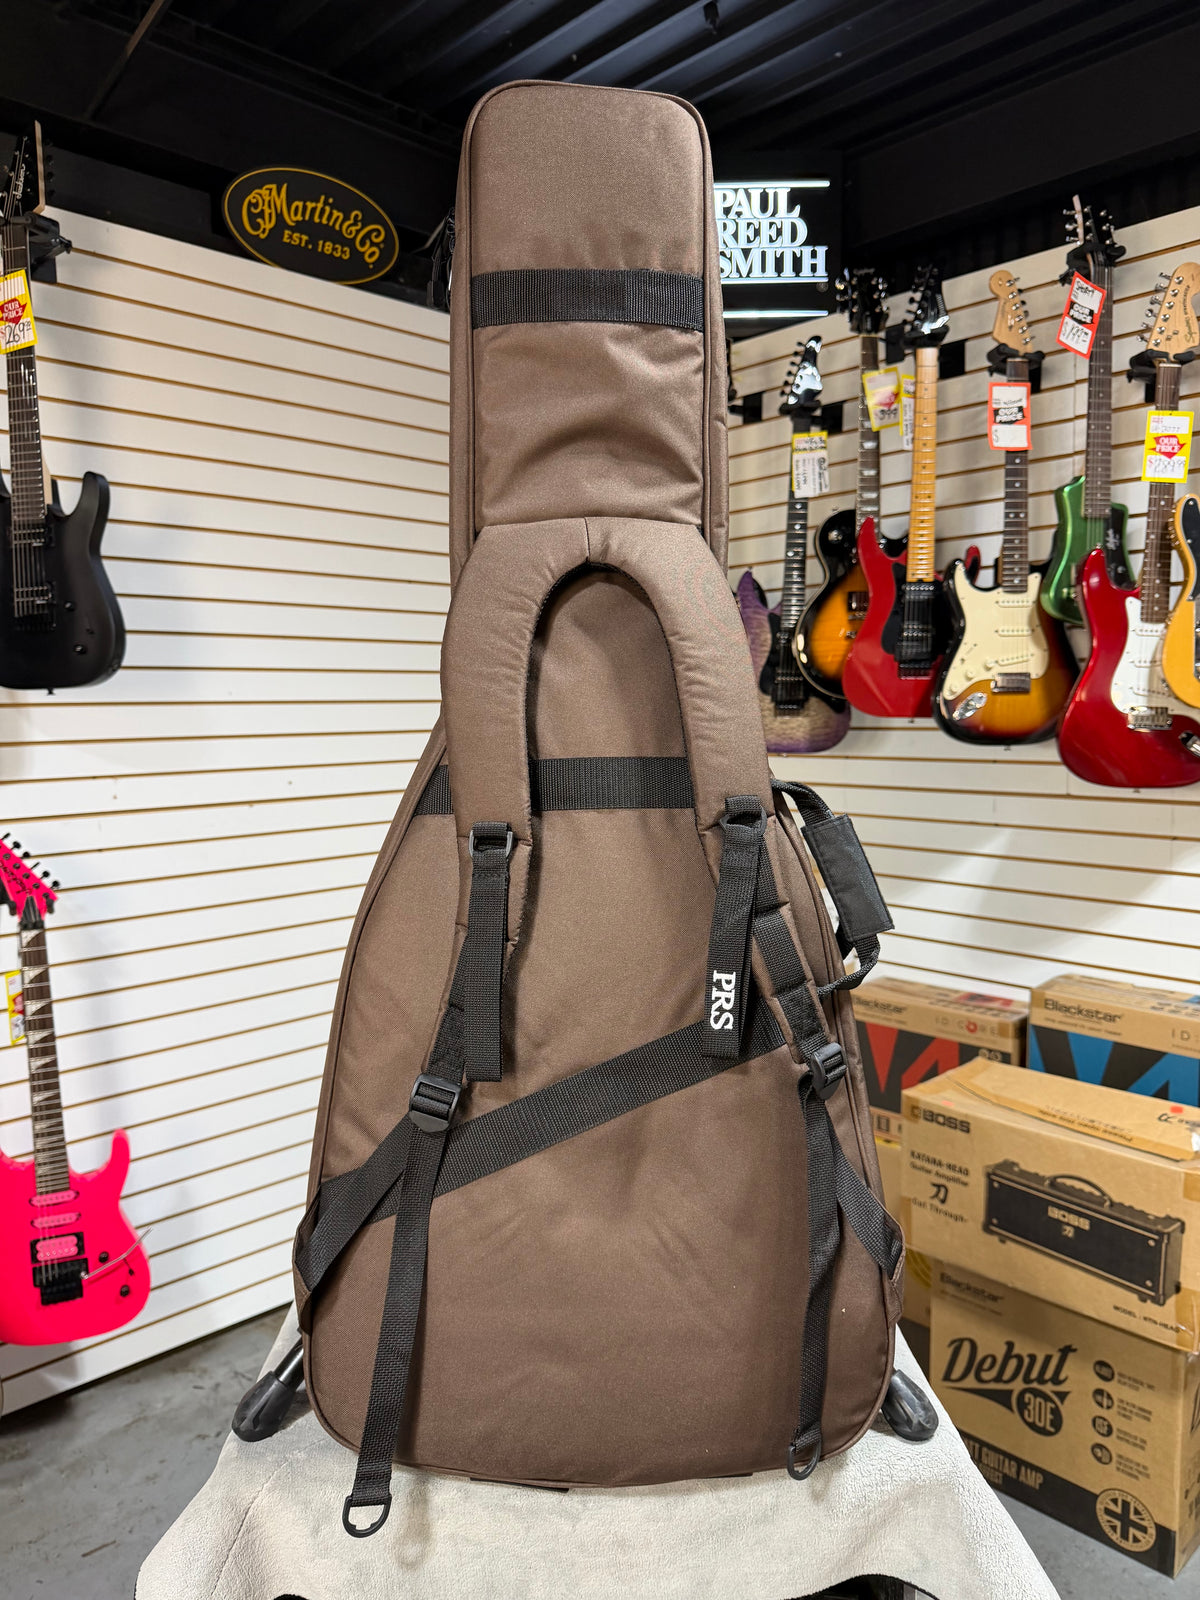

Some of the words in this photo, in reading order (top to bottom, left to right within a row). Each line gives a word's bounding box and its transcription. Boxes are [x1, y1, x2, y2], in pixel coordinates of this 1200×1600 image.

[714, 187, 801, 219] PAUL
[282, 230, 313, 249] EST.
[317, 240, 351, 260] 1833
[716, 217, 808, 248] REED
[719, 245, 829, 278] SMITH
[4, 301, 20, 312] OUR
[710, 970, 736, 1030] PRS
[1043, 998, 1124, 1023] Blackstar
[923, 1109, 970, 1134] BOSS
[1047, 1205, 1091, 1231] BOSS
[941, 1337, 1078, 1386] Debut
[1023, 1392, 1056, 1432] 30E
[981, 1446, 1018, 1479] GUITAR
[1019, 1465, 1044, 1490] AMP
